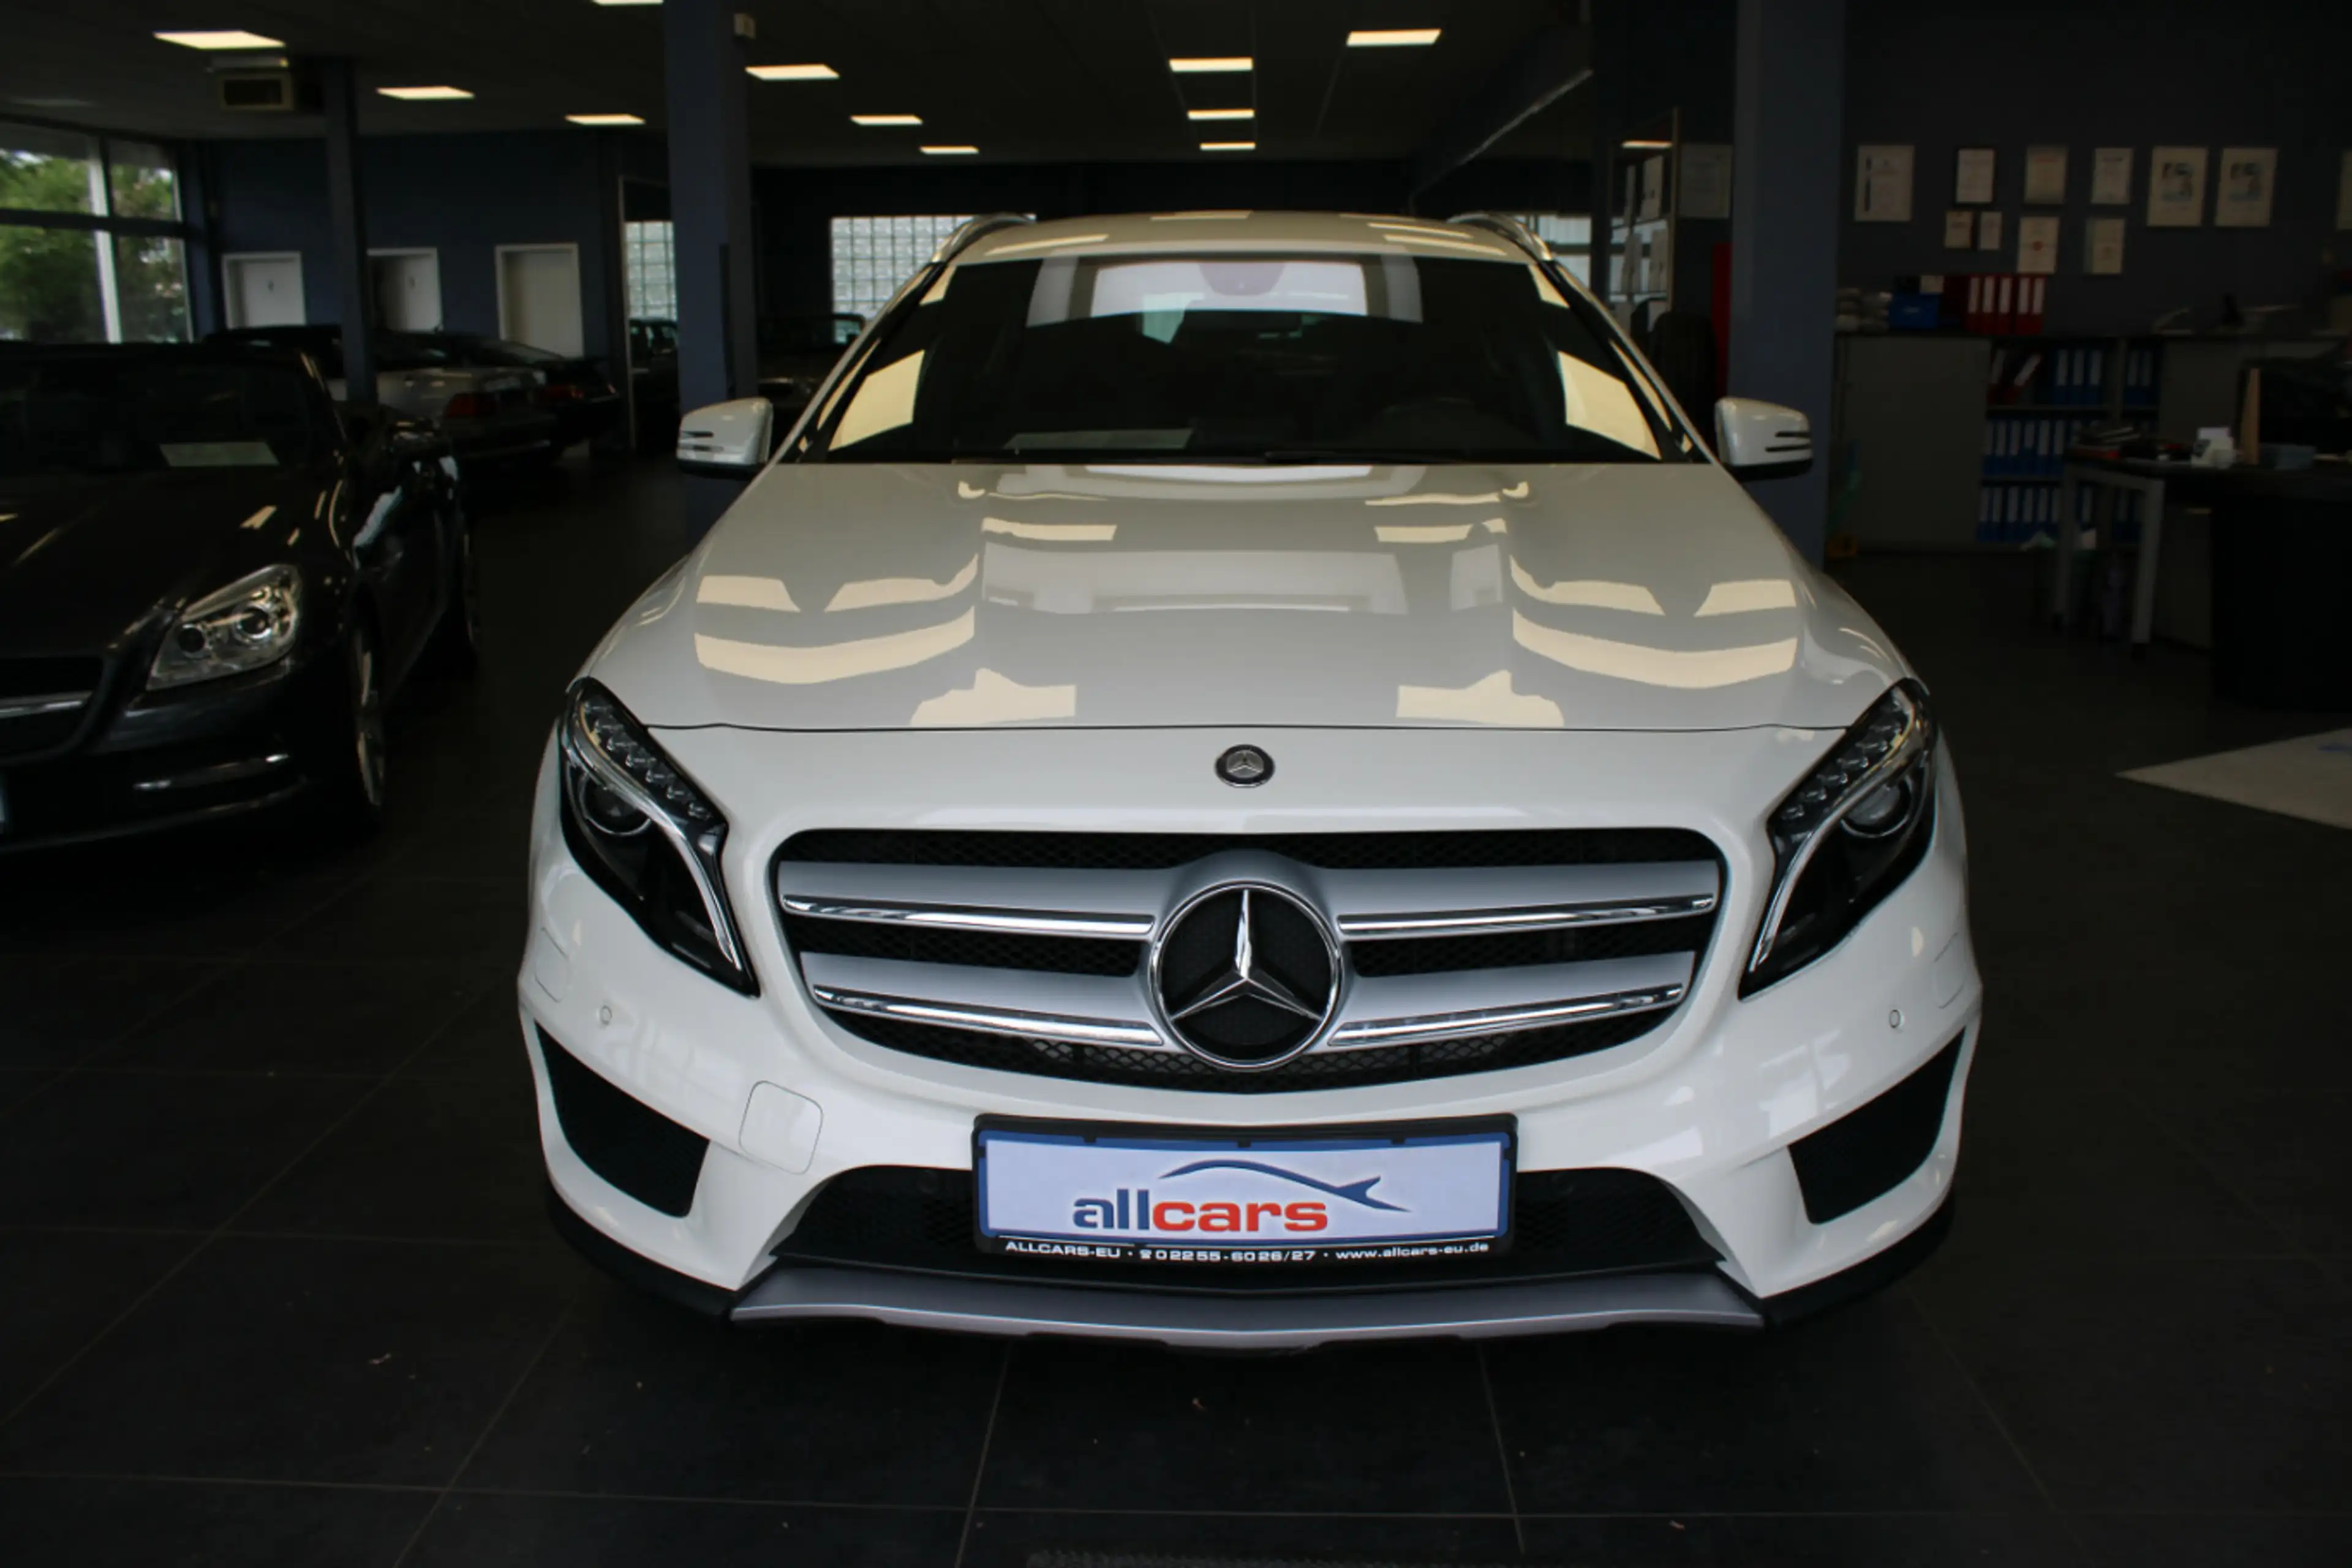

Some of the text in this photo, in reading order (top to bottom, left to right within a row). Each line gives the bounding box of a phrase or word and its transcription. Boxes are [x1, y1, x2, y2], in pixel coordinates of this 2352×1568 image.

[1073, 1189, 1328, 1232] allcars
[1006, 1241, 1121, 1258] ALLCARS-EU
[1335, 1242, 1489, 1259] www.allcars-eu.de
